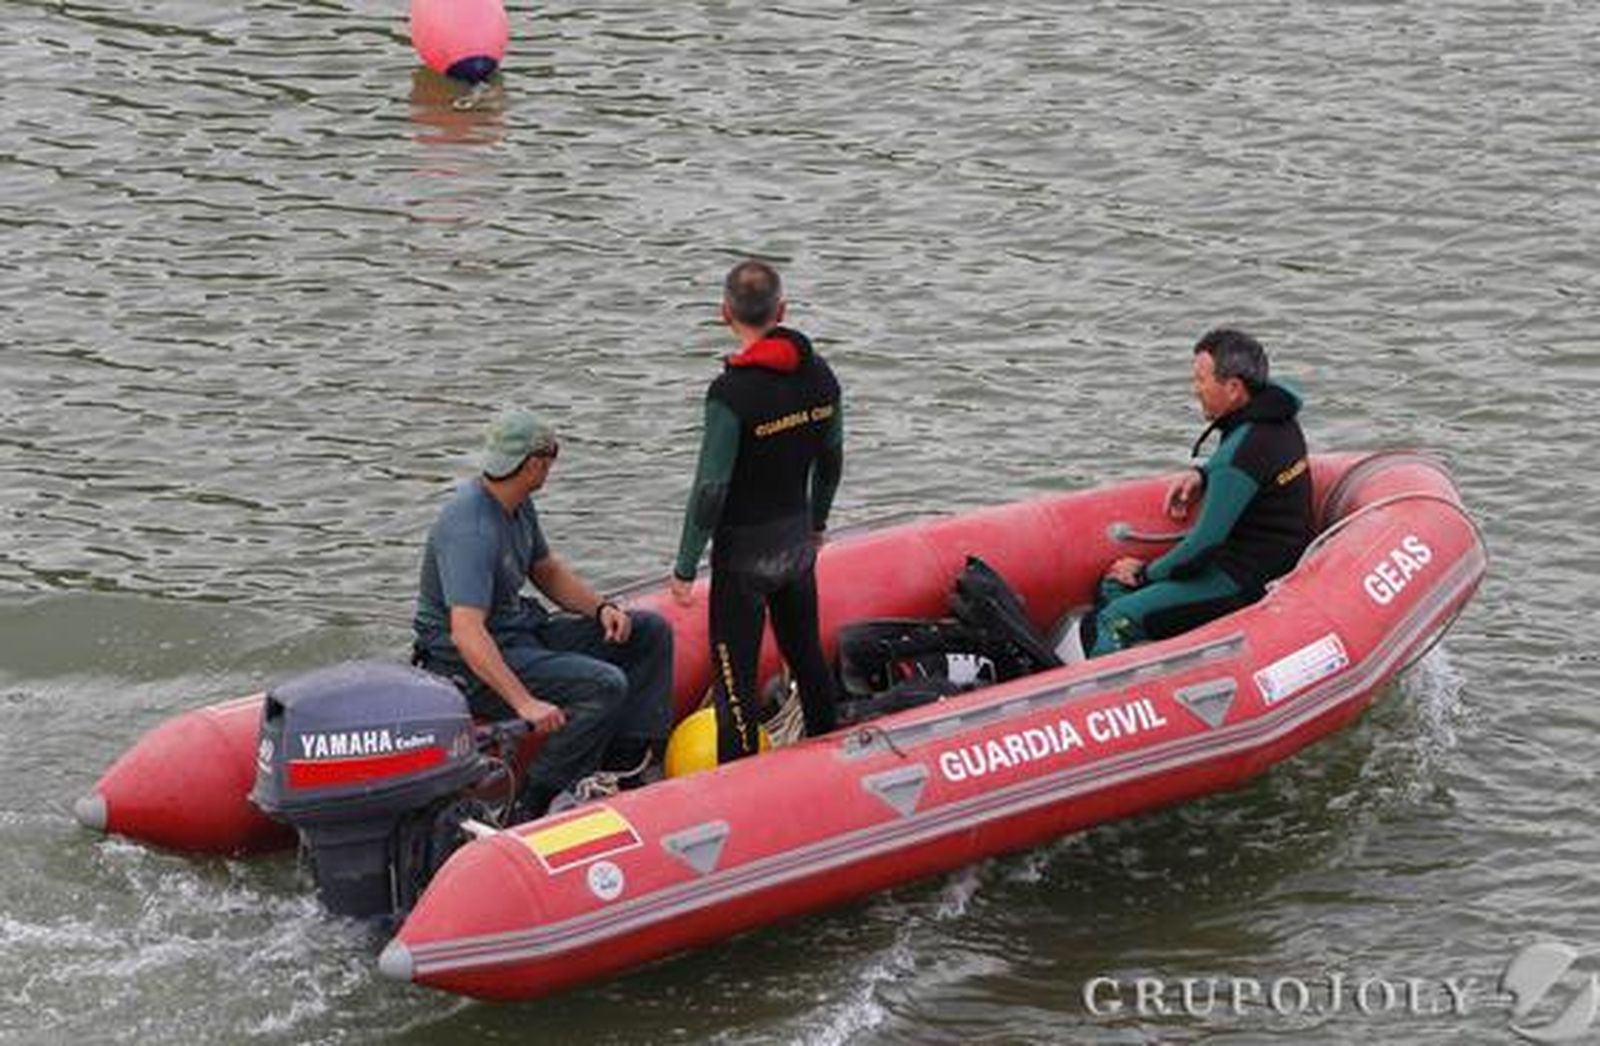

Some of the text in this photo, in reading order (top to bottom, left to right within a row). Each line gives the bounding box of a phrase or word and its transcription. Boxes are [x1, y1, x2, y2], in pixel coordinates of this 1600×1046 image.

[1363, 535, 1433, 606] GEAS
[301, 729, 393, 758] YAMAHA
[939, 698, 1167, 782] GUARDIA CIVIL
